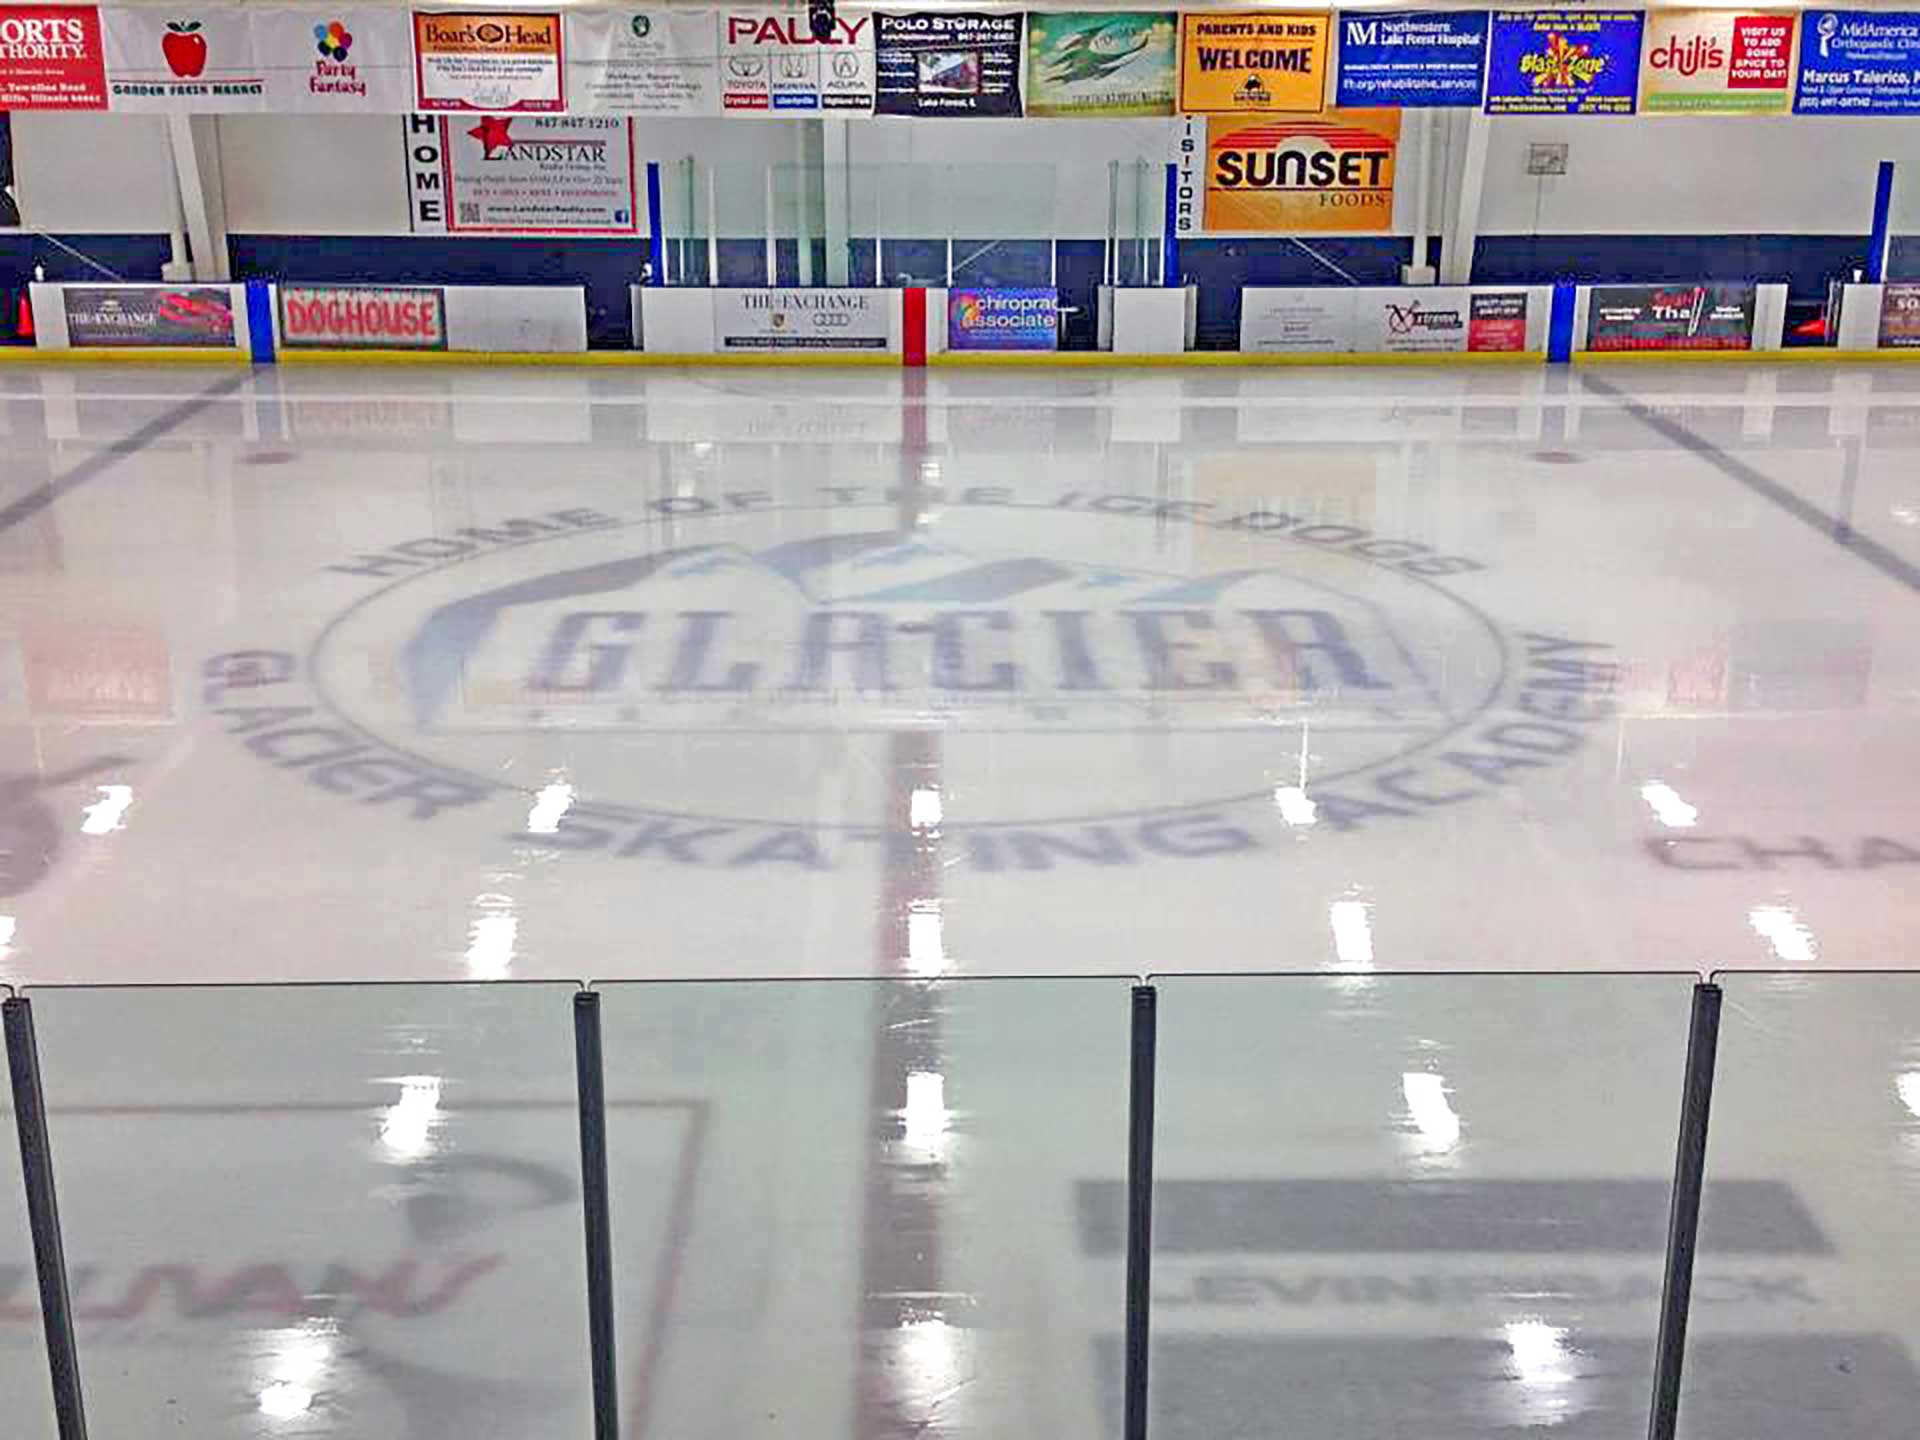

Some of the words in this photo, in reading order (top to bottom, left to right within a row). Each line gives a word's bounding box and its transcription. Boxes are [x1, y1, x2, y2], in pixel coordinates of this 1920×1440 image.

[881, 17, 929, 31] POLO
[932, 17, 1015, 31] STORAGE
[1197, 23, 1254, 36] PARENTS
[1257, 24, 1283, 36] AND
[1287, 25, 1316, 36] KIDS
[1741, 27, 1768, 36] VISIT
[1770, 27, 1786, 36] US
[425, 23, 477, 43] Boar's
[506, 24, 551, 45] Head
[1743, 38, 1757, 47] TO
[1197, 47, 1313, 72] WELCOME
[1650, 35, 1724, 76] chili's
[316, 60, 355, 80] Party
[1736, 59, 1766, 68] SPICE
[1770, 59, 1785, 68] TO
[1732, 69, 1761, 79] YOUR
[1803, 69, 1849, 83] Marcus
[309, 77, 366, 97] Fantasy
[728, 80, 767, 90] TOYOTA
[827, 81, 866, 89] ACURA
[411, 115, 441, 221] HOME
[1216, 151, 1388, 186] SUNSET
[1320, 194, 1385, 207] FOODS
[743, 295, 772, 310] THE
[782, 295, 869, 310] EXCHANGE
[287, 300, 435, 336] DOGHOUSE
[325, 506, 622, 578] HOME
[522, 608, 1394, 693] GLACIER
